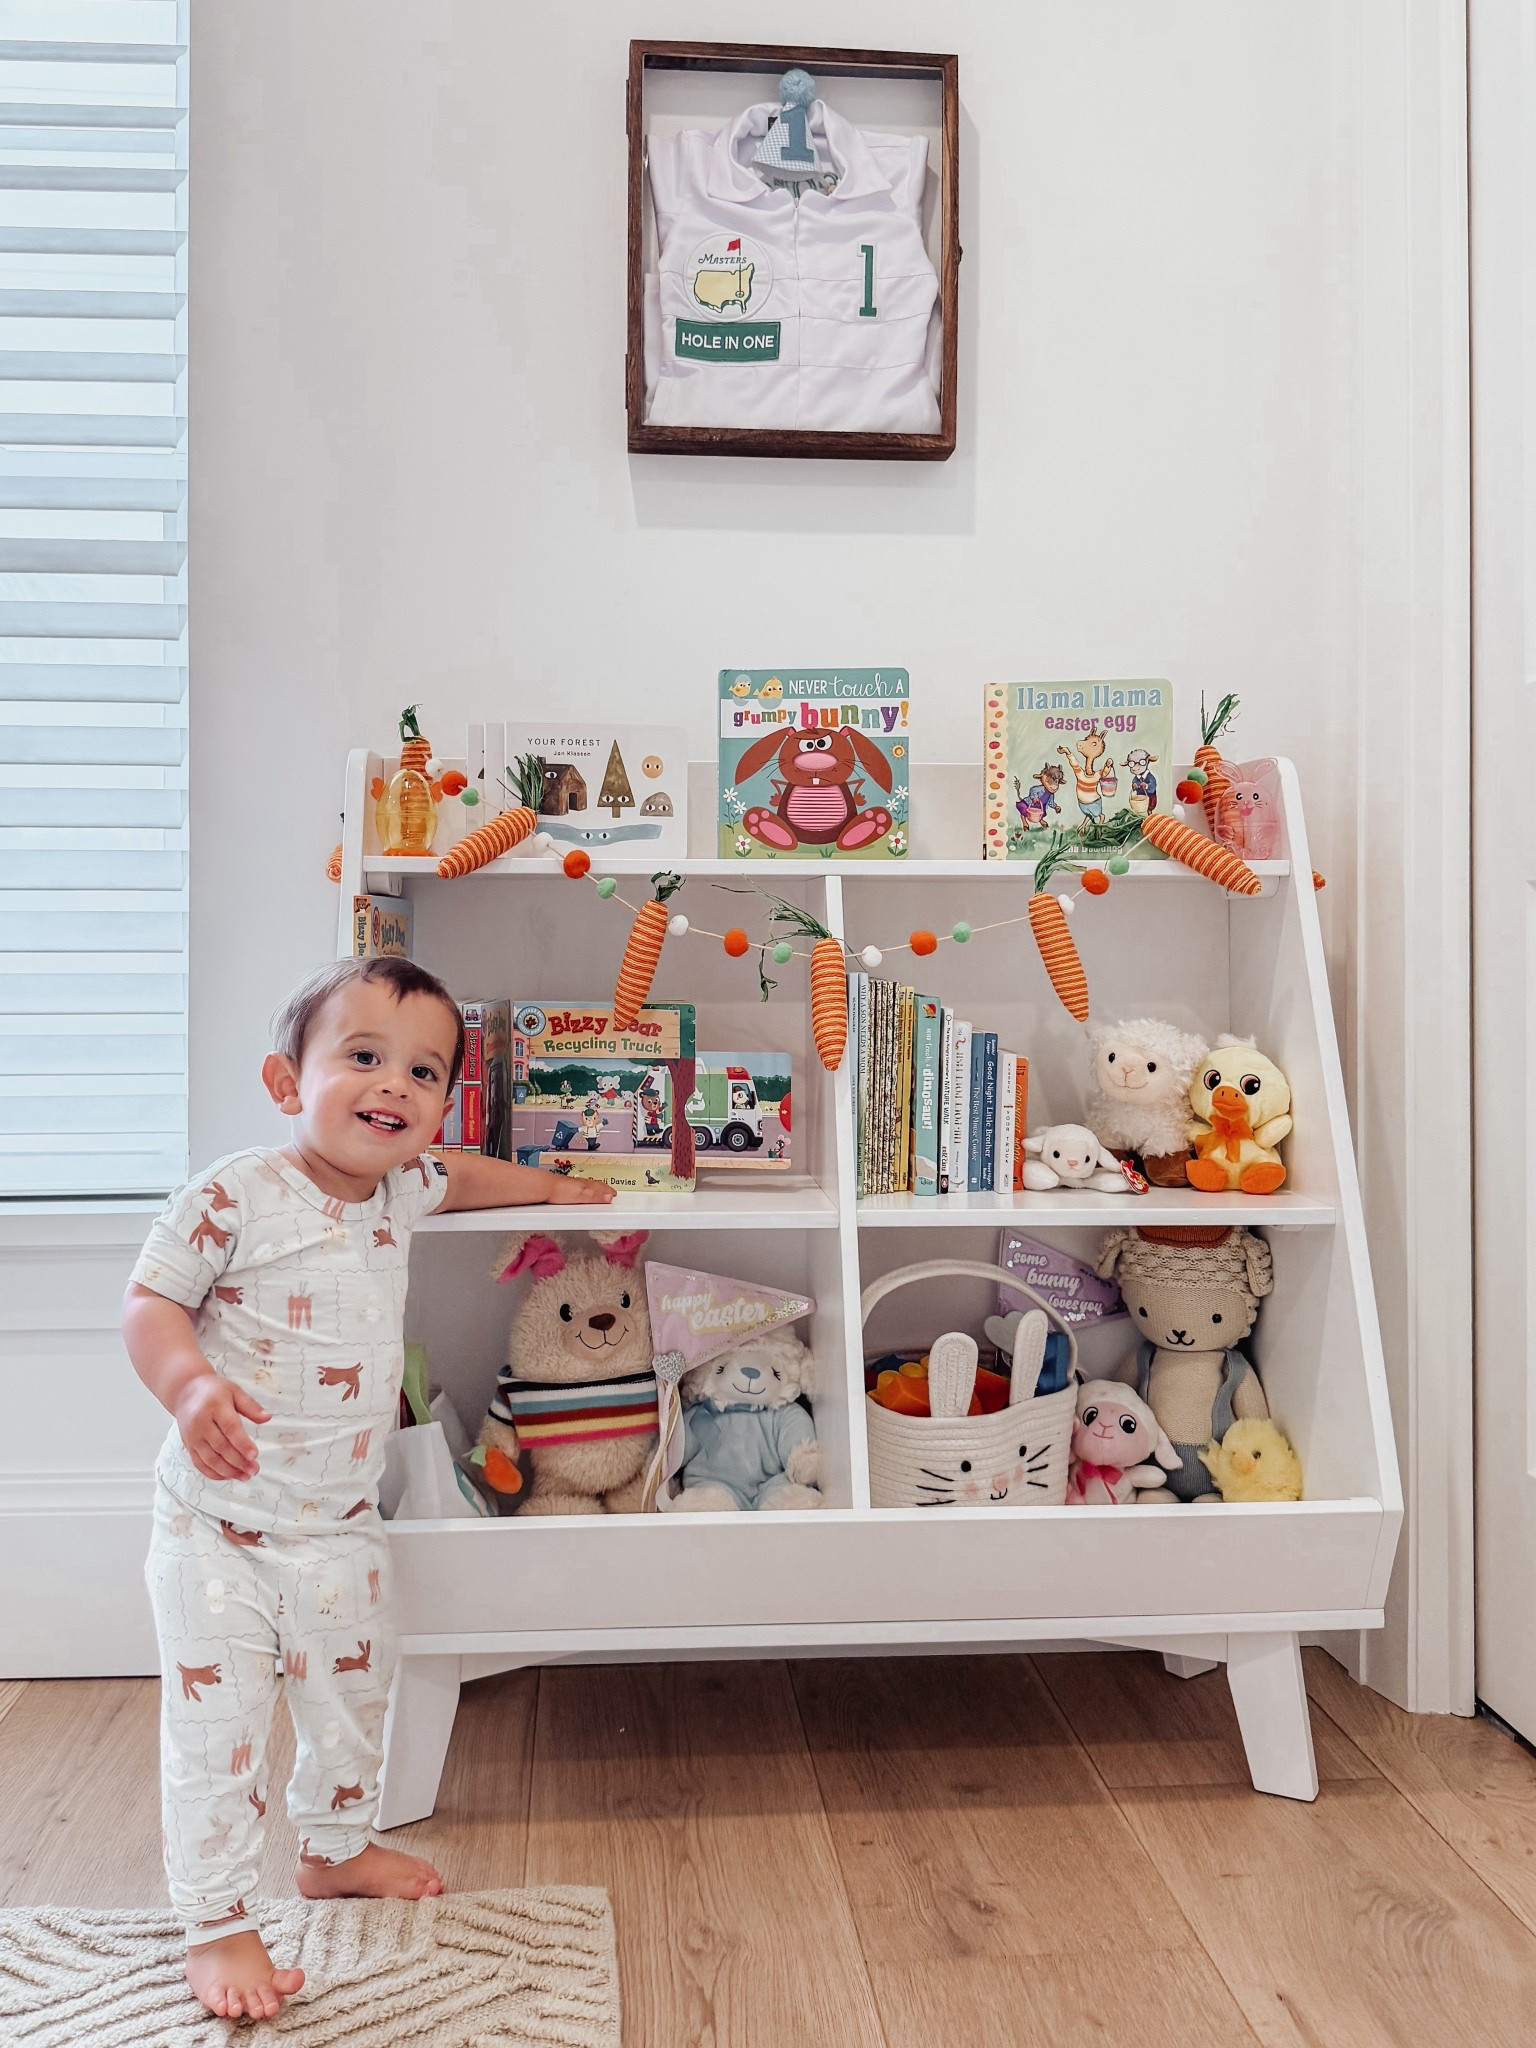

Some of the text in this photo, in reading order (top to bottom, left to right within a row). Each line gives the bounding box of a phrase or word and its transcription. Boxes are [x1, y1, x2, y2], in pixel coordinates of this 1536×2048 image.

[858, 245, 878, 317] 1
[681, 332, 774, 350] HOLE IN ONE
[788, 672, 904, 697] NEVER touch A
[1017, 684, 1162, 710] llama llama
[733, 700, 910, 733] grumpy bunny!
[1044, 714, 1137, 732] easter egg
[527, 737, 601, 747] YOUR FOREST
[548, 1011, 608, 1036] Bizzy
[543, 1037, 662, 1054] Recycling Truck
[921, 1068, 934, 1130] dinosaur!
[972, 1086, 980, 1099] The
[985, 1082, 994, 1104] Night
[972, 1100, 980, 1114] Best
[985, 1107, 993, 1127] Little
[1015, 1083, 1023, 1134] GOODNIGHT
[971, 1138, 979, 1161] Cookie
[984, 1129, 993, 1158] Brother
[1013, 1136, 1022, 1163] MOON
[611, 1177, 636, 1185] Davies
[1013, 1252, 1048, 1267] some
[1026, 1267, 1080, 1297] bunny
[661, 1292, 712, 1312] happy
[691, 1297, 768, 1330] easter
[1048, 1293, 1103, 1316] loves you
